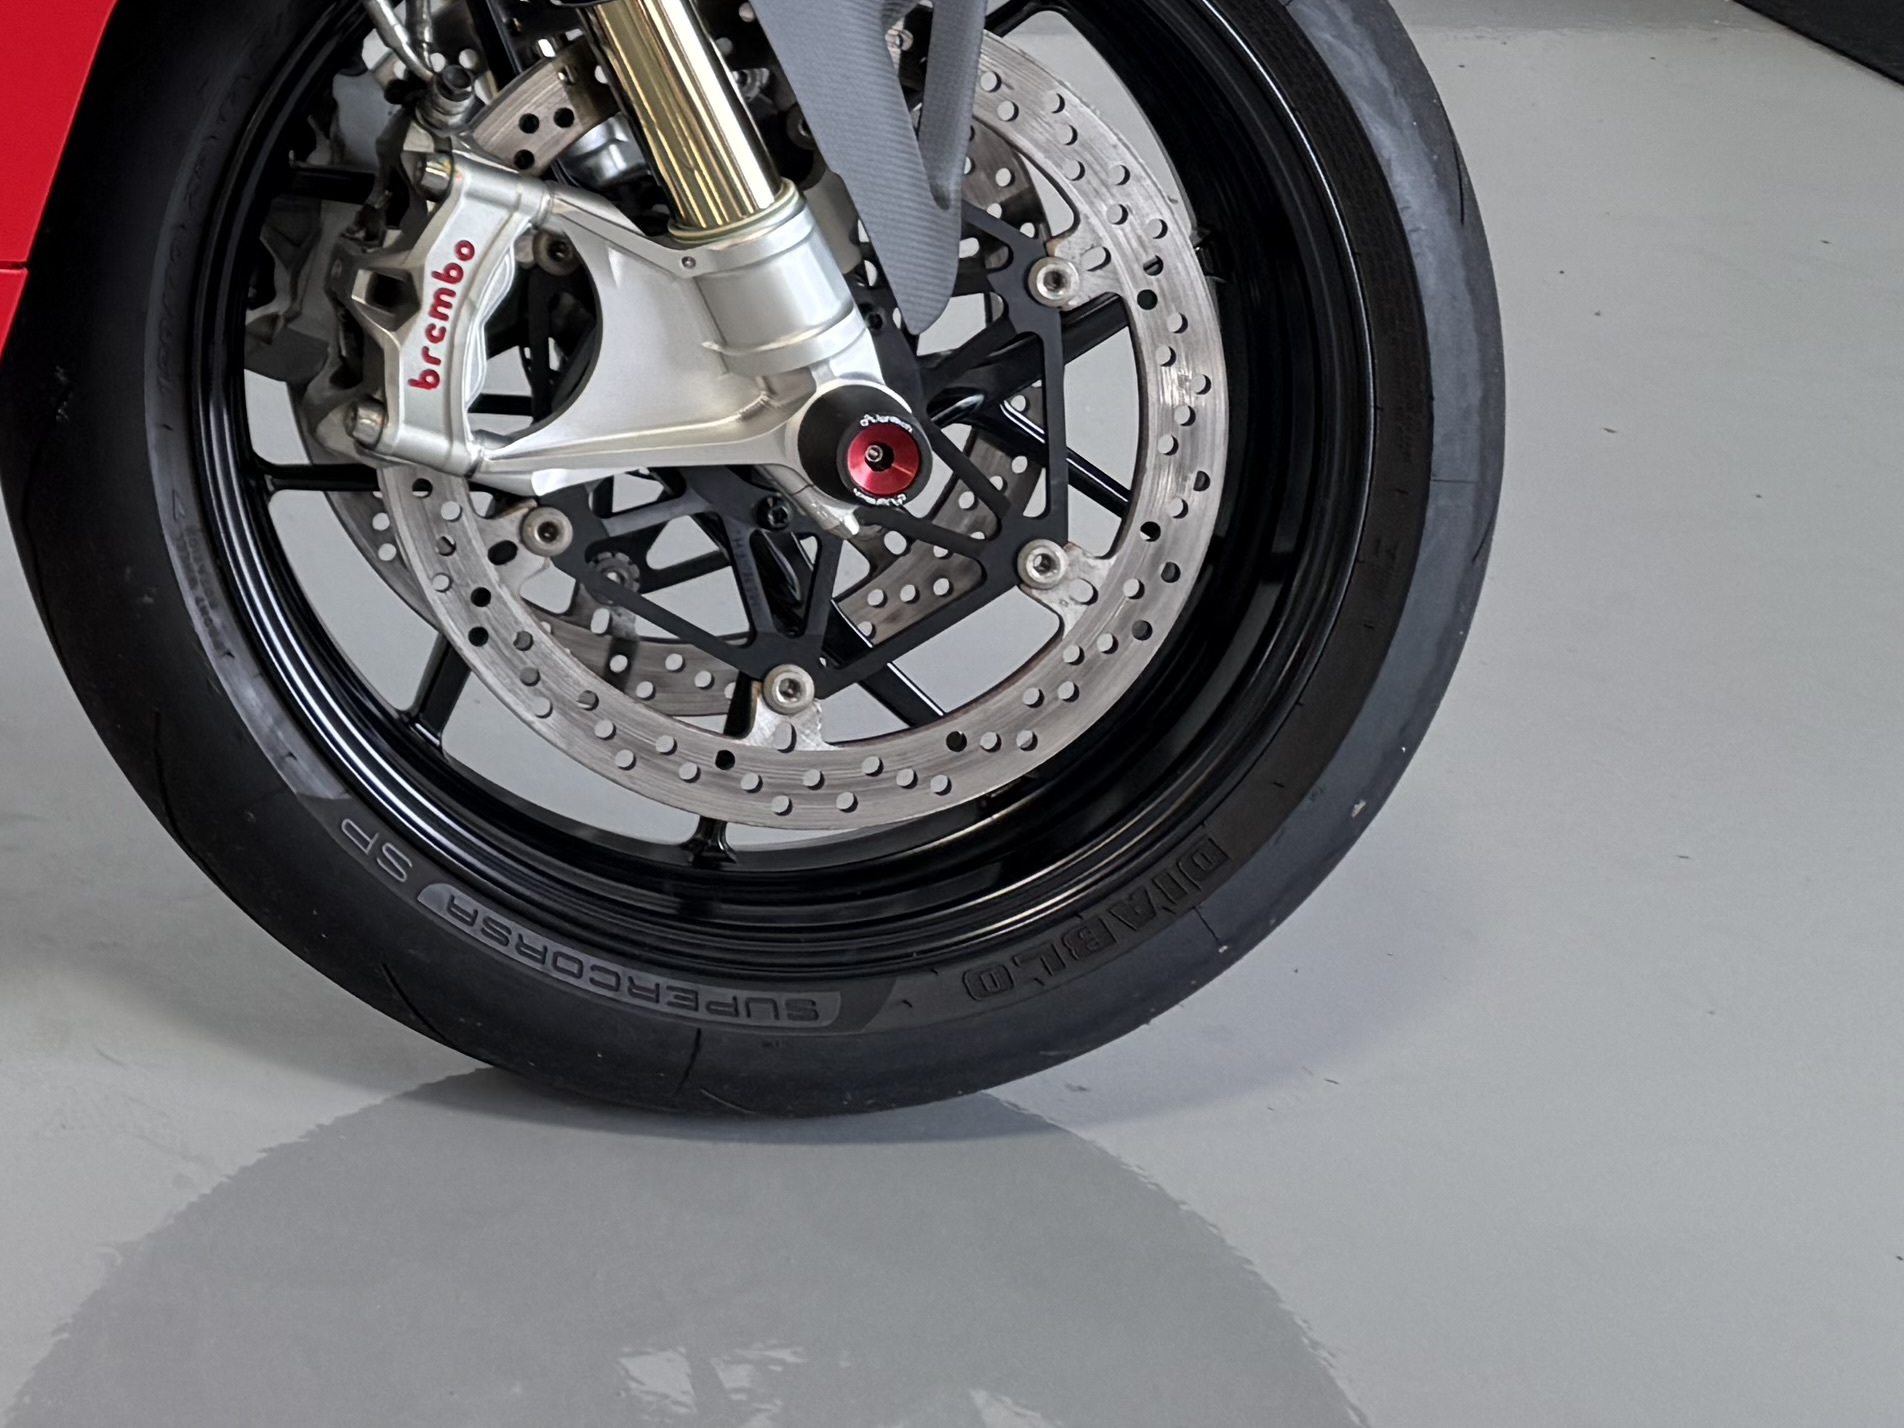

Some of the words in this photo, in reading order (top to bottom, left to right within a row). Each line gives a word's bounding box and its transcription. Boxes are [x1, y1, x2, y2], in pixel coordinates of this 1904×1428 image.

[407, 238, 477, 392] brembo
[340, 818, 414, 883] SP
[963, 835, 1233, 1003] DIABLO
[445, 893, 820, 1024] SUPERCORSA
